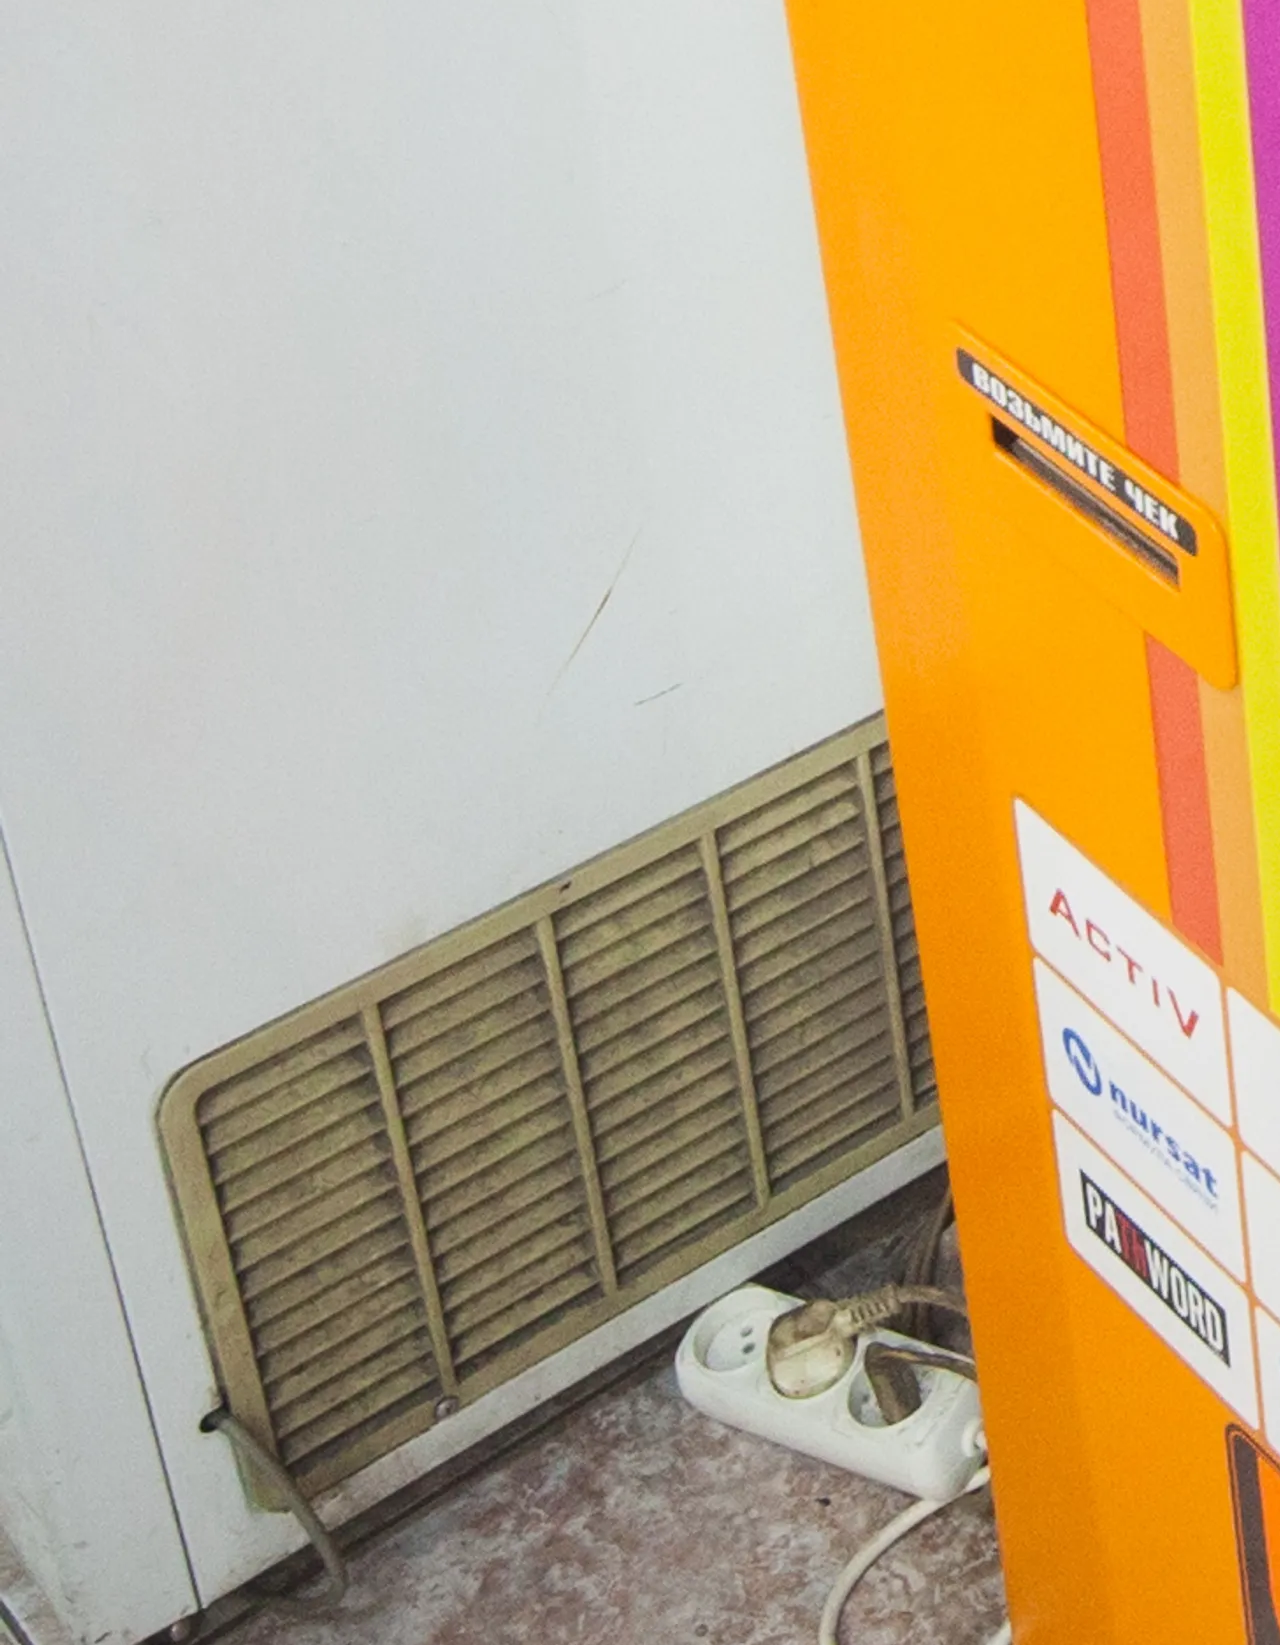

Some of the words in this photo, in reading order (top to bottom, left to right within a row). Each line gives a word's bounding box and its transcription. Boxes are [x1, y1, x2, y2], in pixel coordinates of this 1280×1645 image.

[971, 361, 1118, 492] ВОЗЬМИТЕ
[1123, 478, 1180, 541] ЧЕК
[1048, 887, 1200, 1042] ACTIV
[1108, 1073, 1220, 1199] nursat
[1083, 1186, 1228, 1357] PATHWORD
